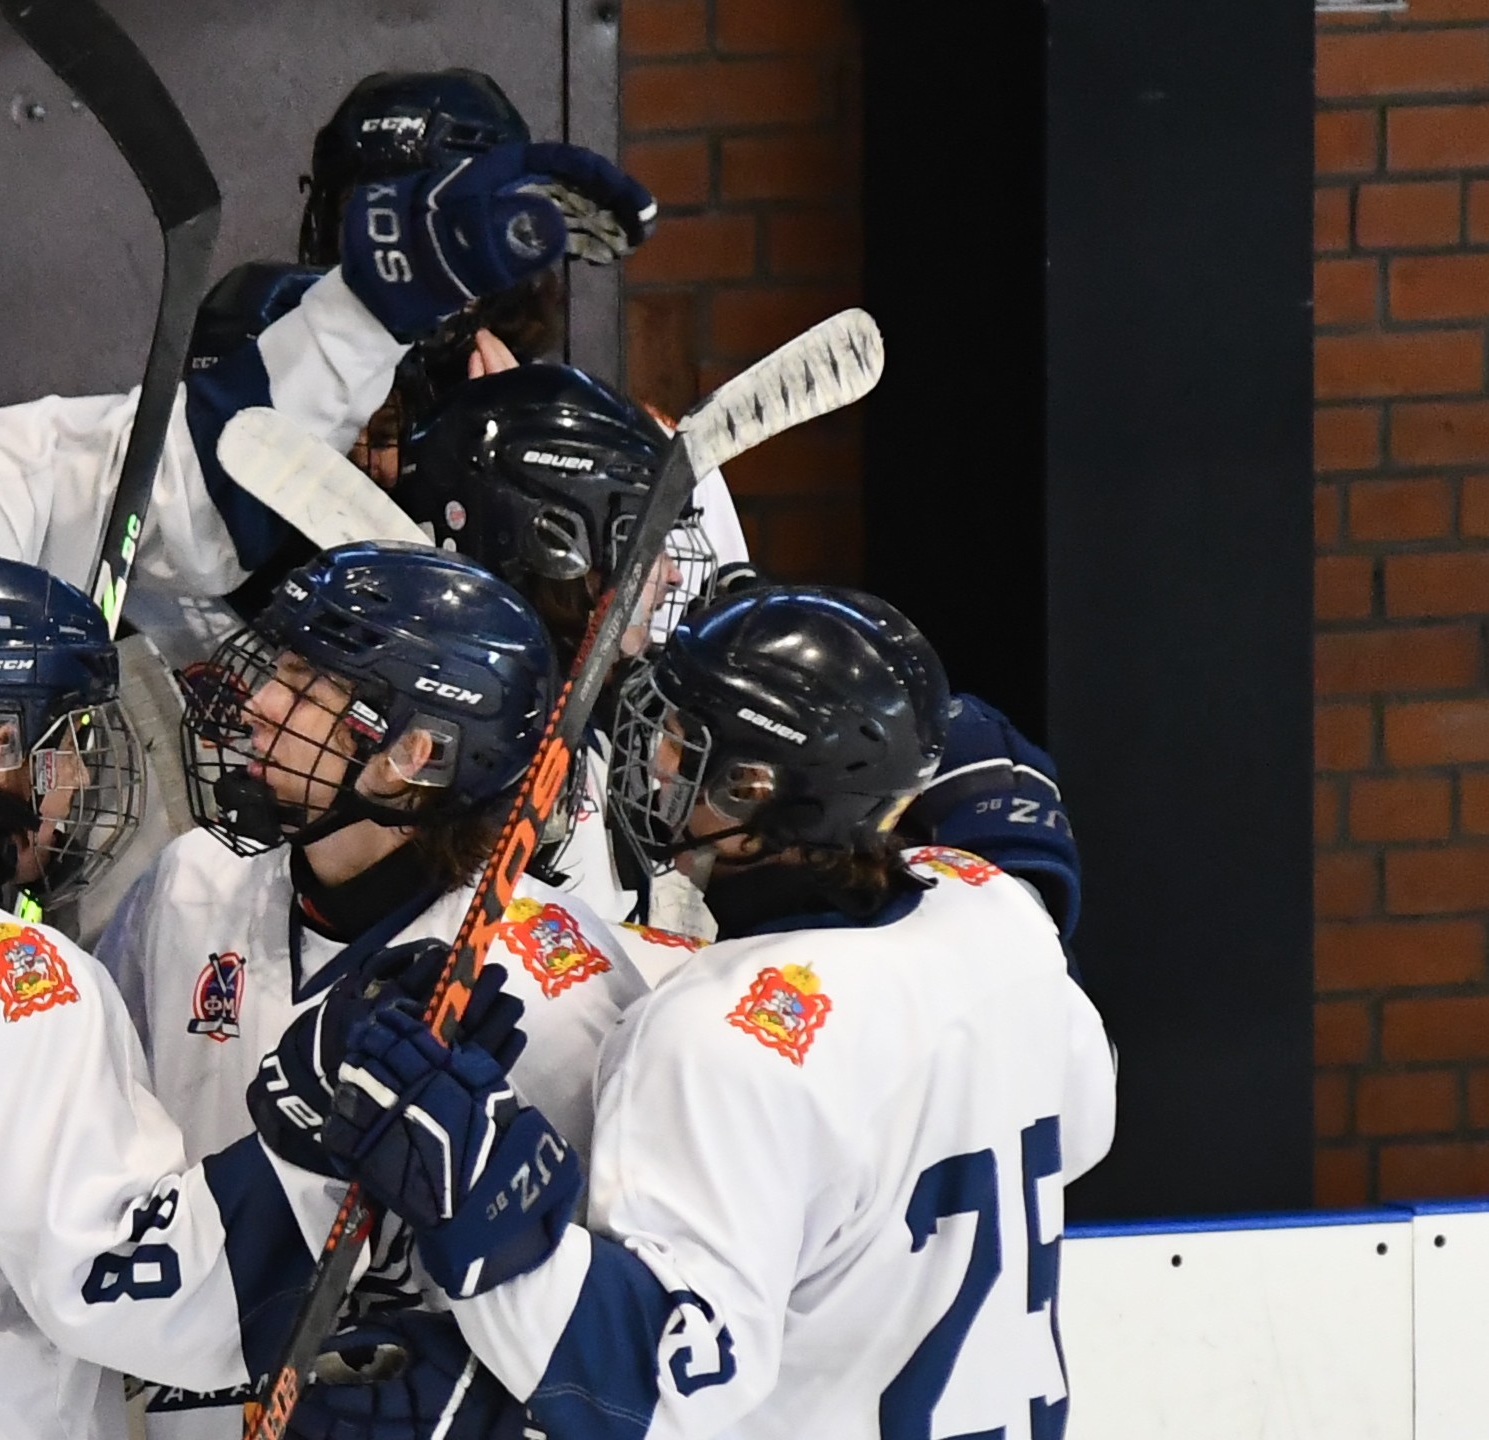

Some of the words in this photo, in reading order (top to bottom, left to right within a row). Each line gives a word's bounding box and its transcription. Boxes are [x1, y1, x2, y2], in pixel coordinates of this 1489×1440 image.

[362, 117, 425, 132] CCM
[523, 450, 594, 471] BAUER
[415, 677, 483, 705] CCM
[737, 708, 807, 745] BAUER
